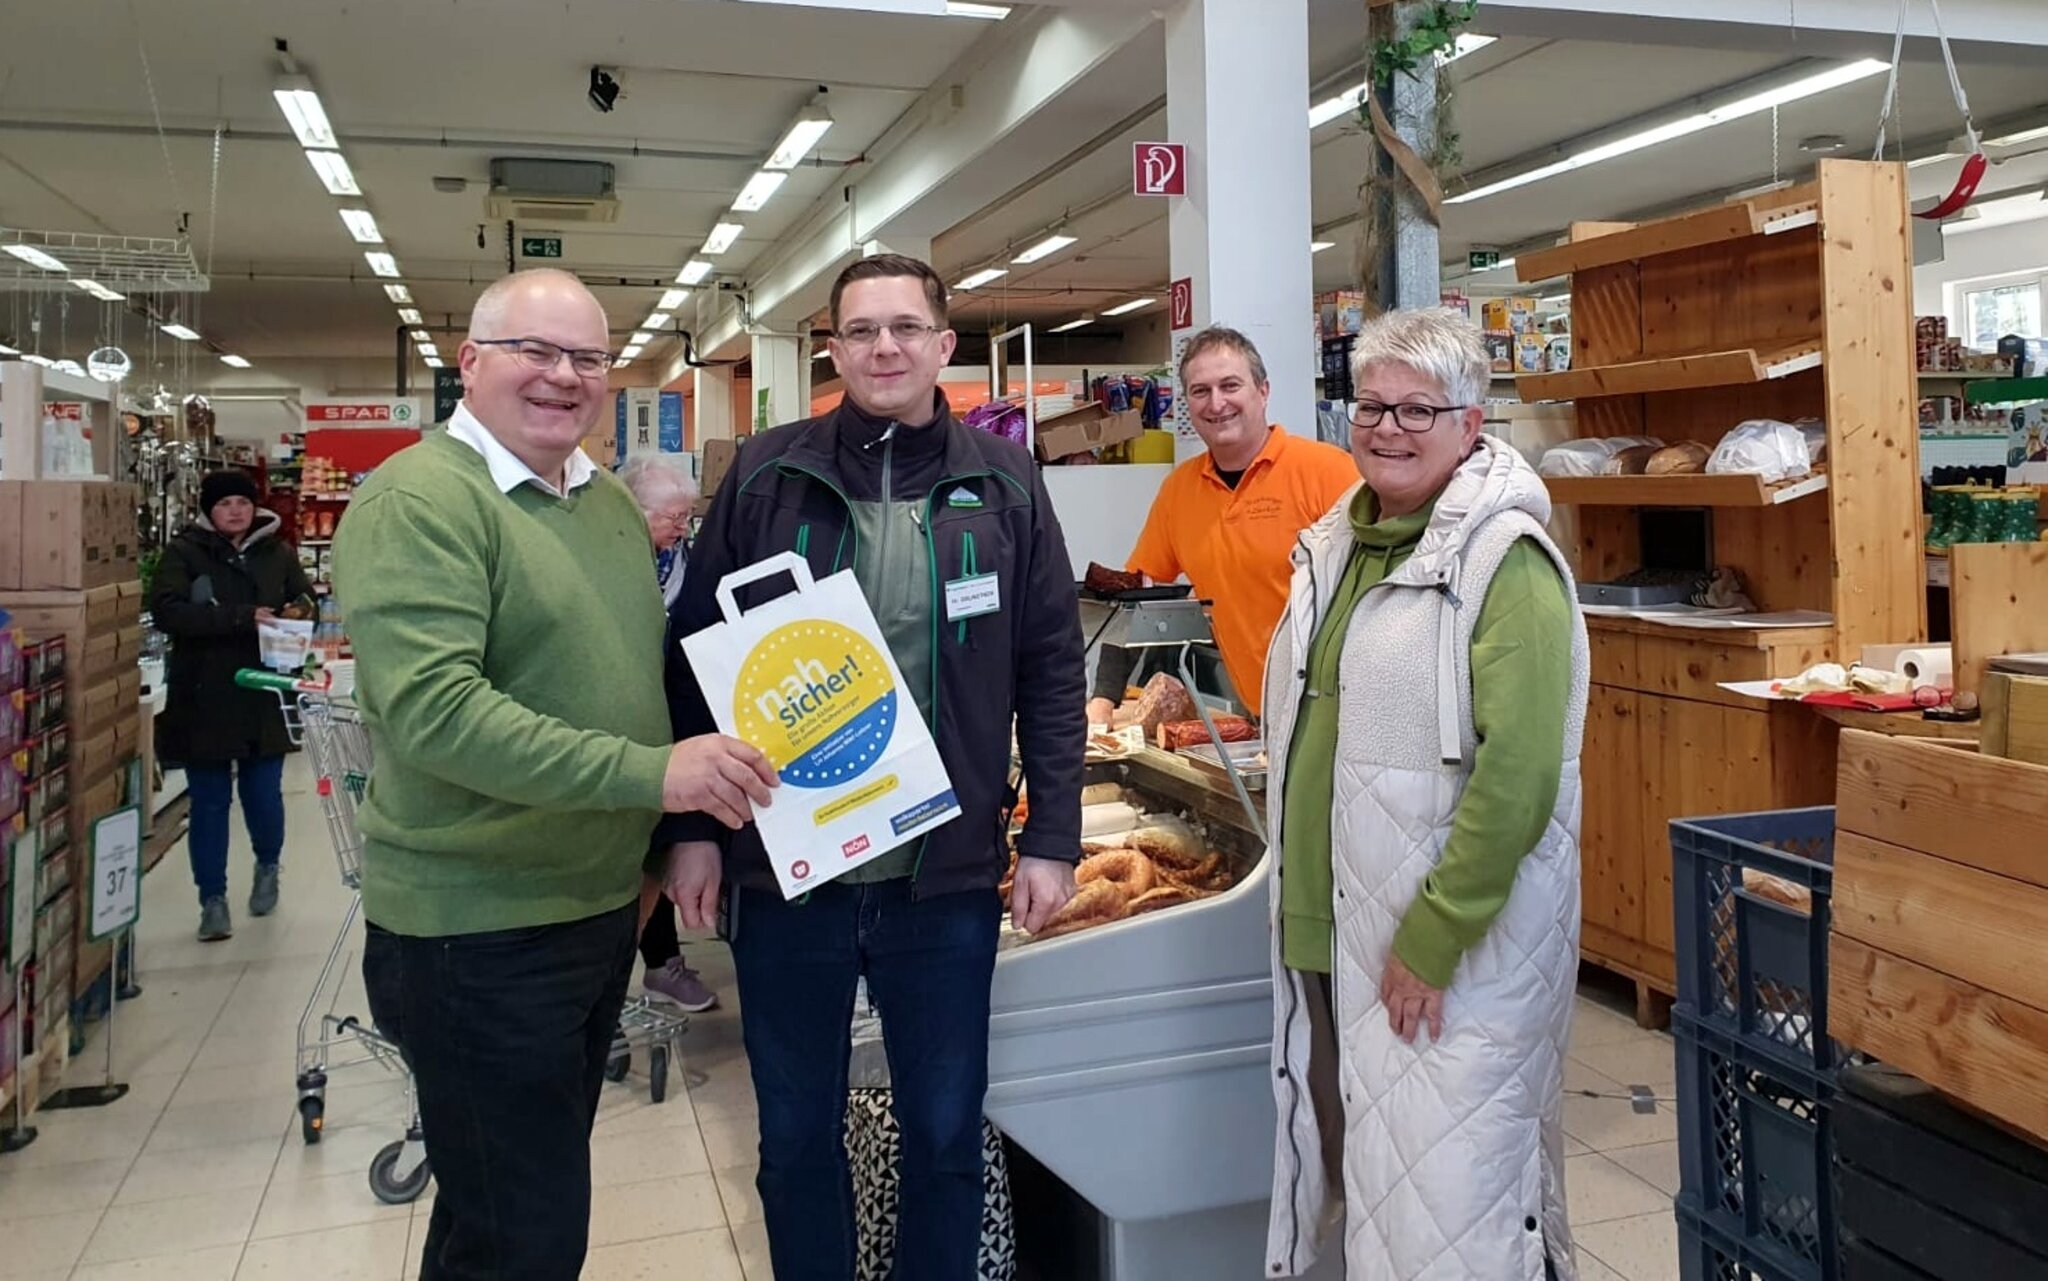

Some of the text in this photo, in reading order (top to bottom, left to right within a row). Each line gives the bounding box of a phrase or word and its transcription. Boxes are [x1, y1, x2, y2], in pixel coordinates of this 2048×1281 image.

[324, 407, 389, 419] SPAR
[755, 657, 831, 724] nah
[778, 654, 864, 729] sicher!
[106, 865, 128, 897] 37
